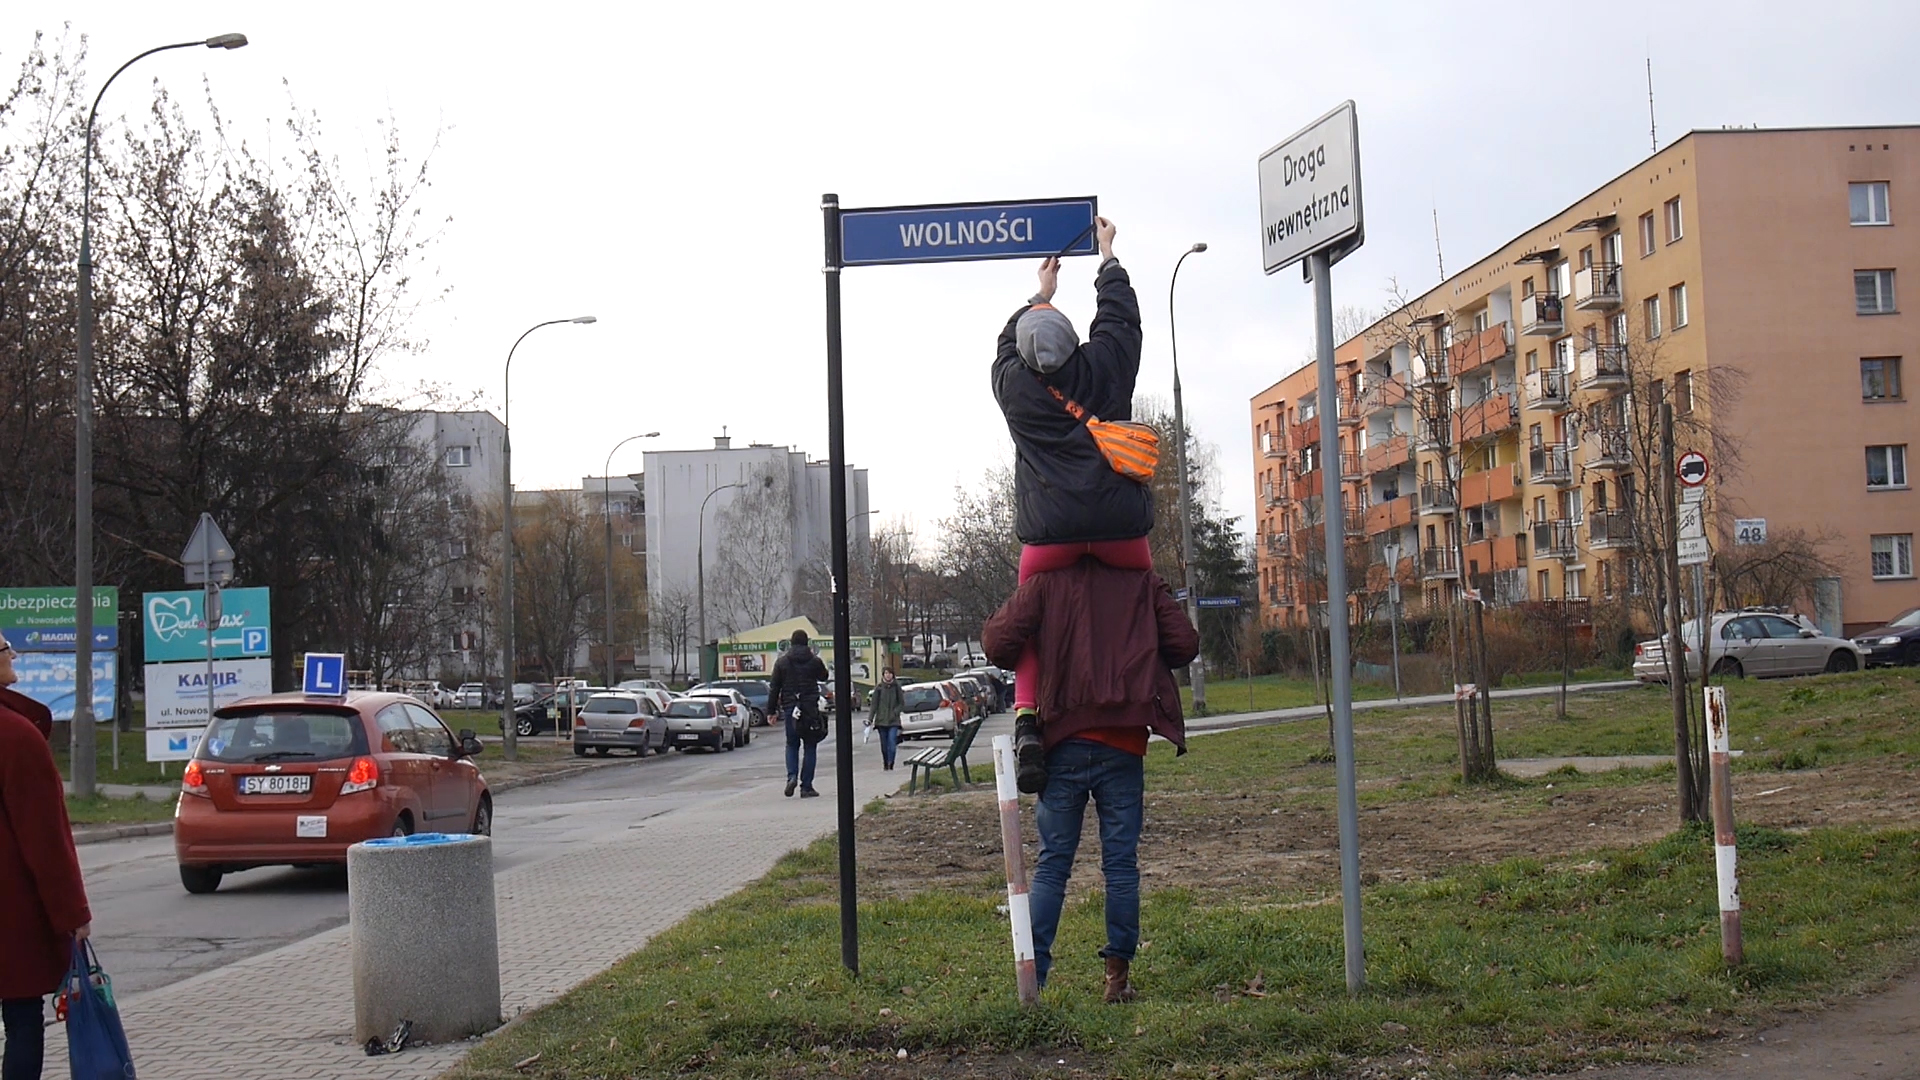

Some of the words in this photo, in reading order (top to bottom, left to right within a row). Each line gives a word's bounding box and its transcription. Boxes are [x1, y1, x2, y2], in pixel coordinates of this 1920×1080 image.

[1283, 144, 1326, 187] Droga
[1266, 184, 1350, 246] wewnętrzna
[899, 212, 1034, 248] WOLNOŚCI
[1739, 527, 1762, 542] 48
[0, 593, 111, 613] ubezpiecznia
[156, 611, 245, 633] Dentaax
[41, 632, 76, 641] MAGNU
[248, 631, 262, 650] P
[178, 672, 238, 687] KAMIR
[316, 661, 332, 688] L
[161, 708, 172, 717] ul.
[247, 778, 265, 791] SY
[269, 776, 308, 790] 8018H
